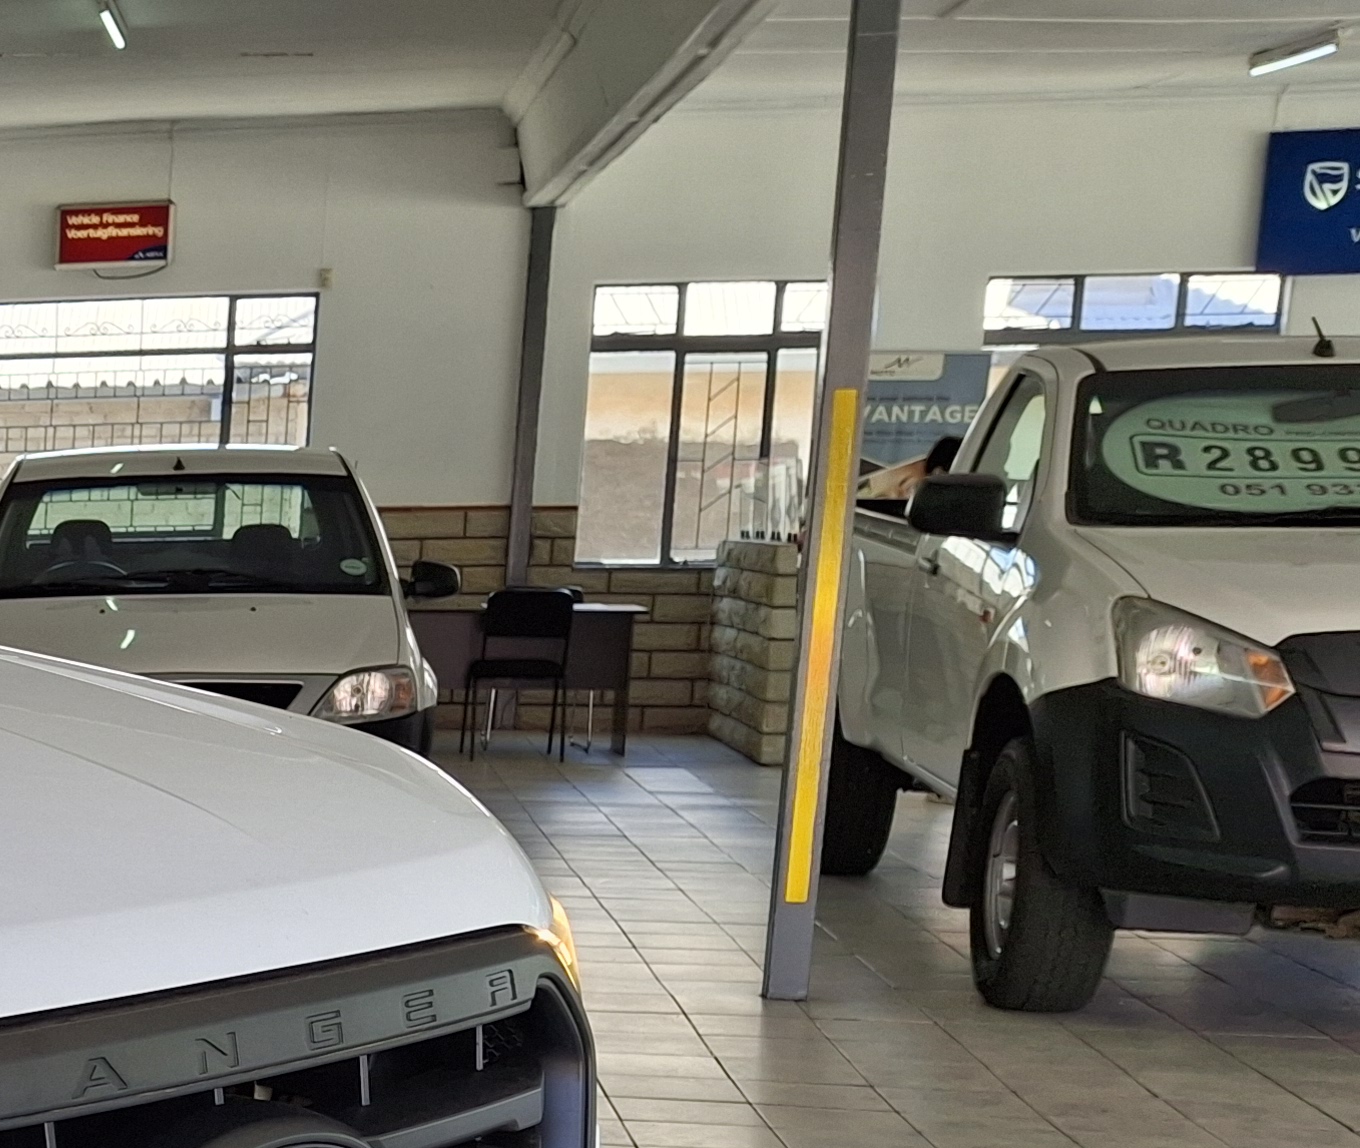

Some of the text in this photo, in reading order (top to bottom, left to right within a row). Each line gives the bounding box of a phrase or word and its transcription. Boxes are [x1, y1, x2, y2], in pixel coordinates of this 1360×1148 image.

[66, 212, 140, 225] Vehicle Finance
[1145, 417, 1275, 436] QUADRO
[1218, 483, 1360, 497] 051 93
